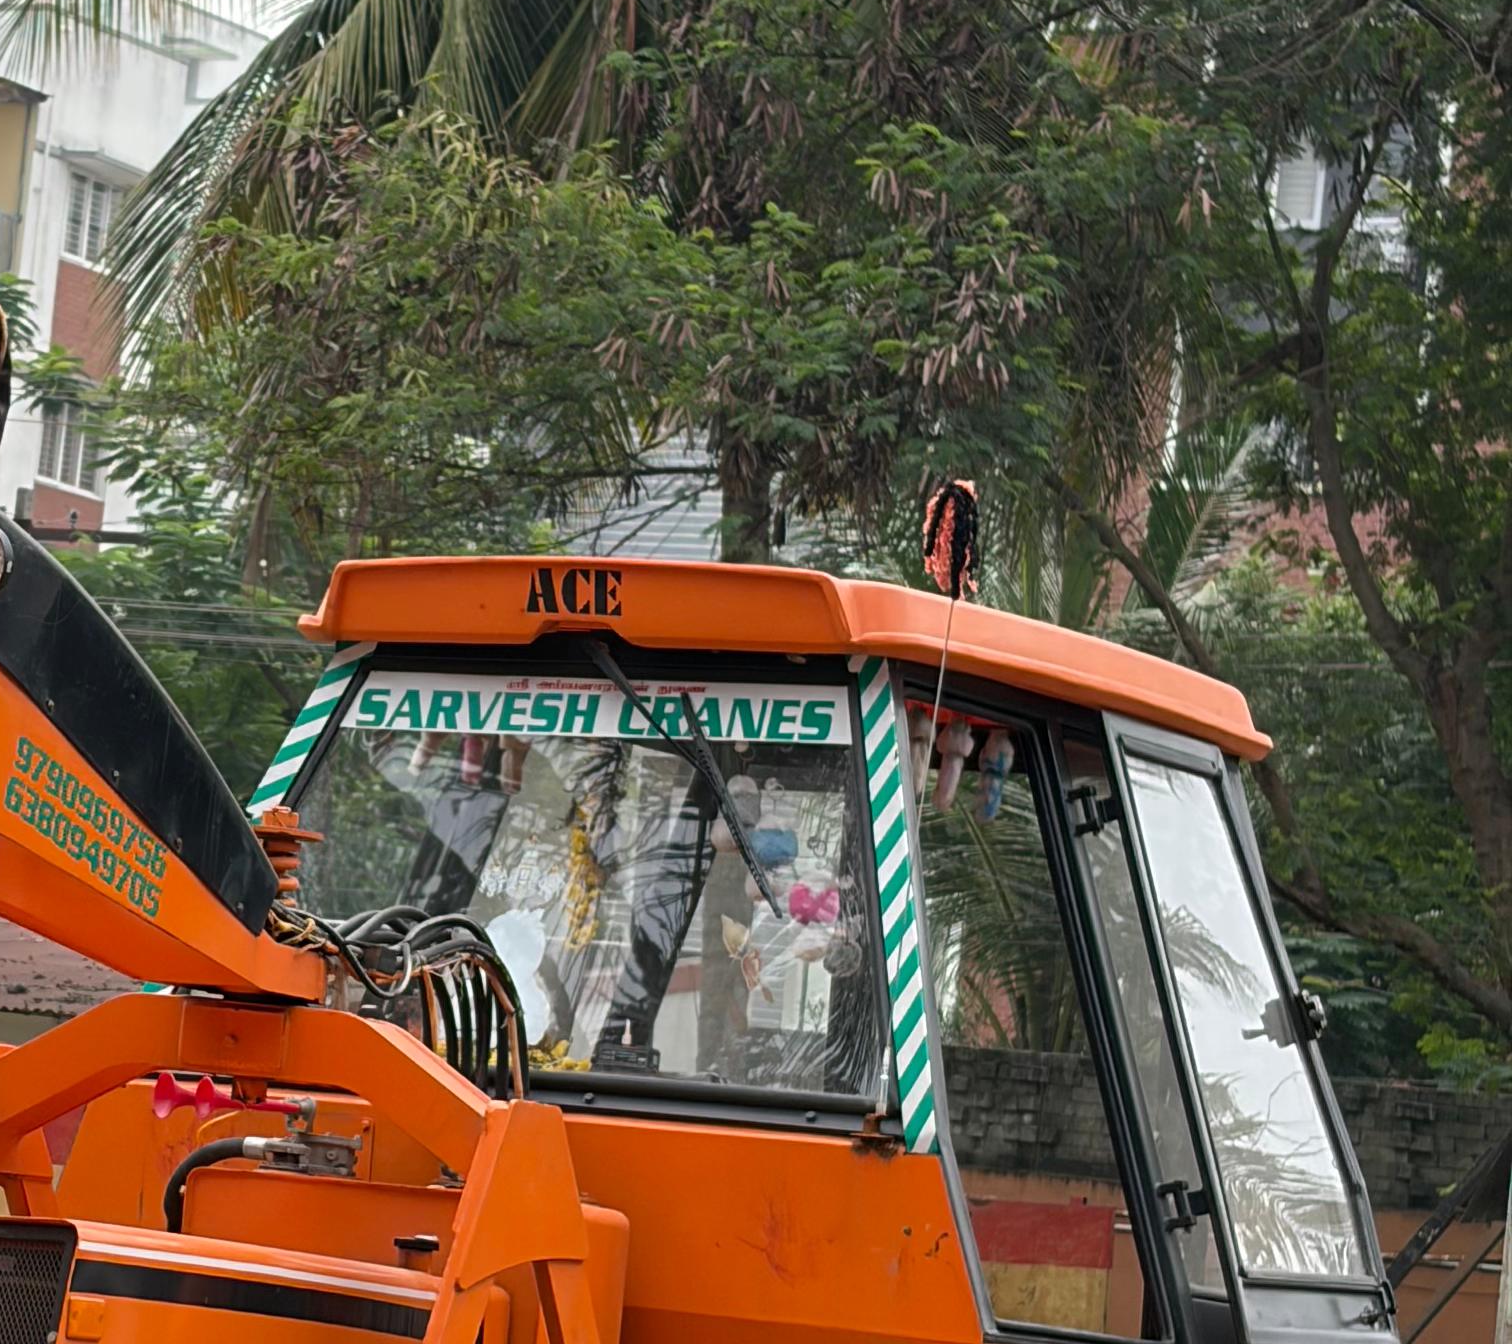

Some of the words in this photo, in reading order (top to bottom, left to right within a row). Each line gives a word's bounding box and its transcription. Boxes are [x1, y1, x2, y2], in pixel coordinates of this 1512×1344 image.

[525, 567, 623, 617] ACE
[356, 689, 600, 734] SARVESH
[618, 697, 836, 744] CRANES
[5, 777, 162, 917] 6380949705
[15, 736, 168, 879] 9790969756
